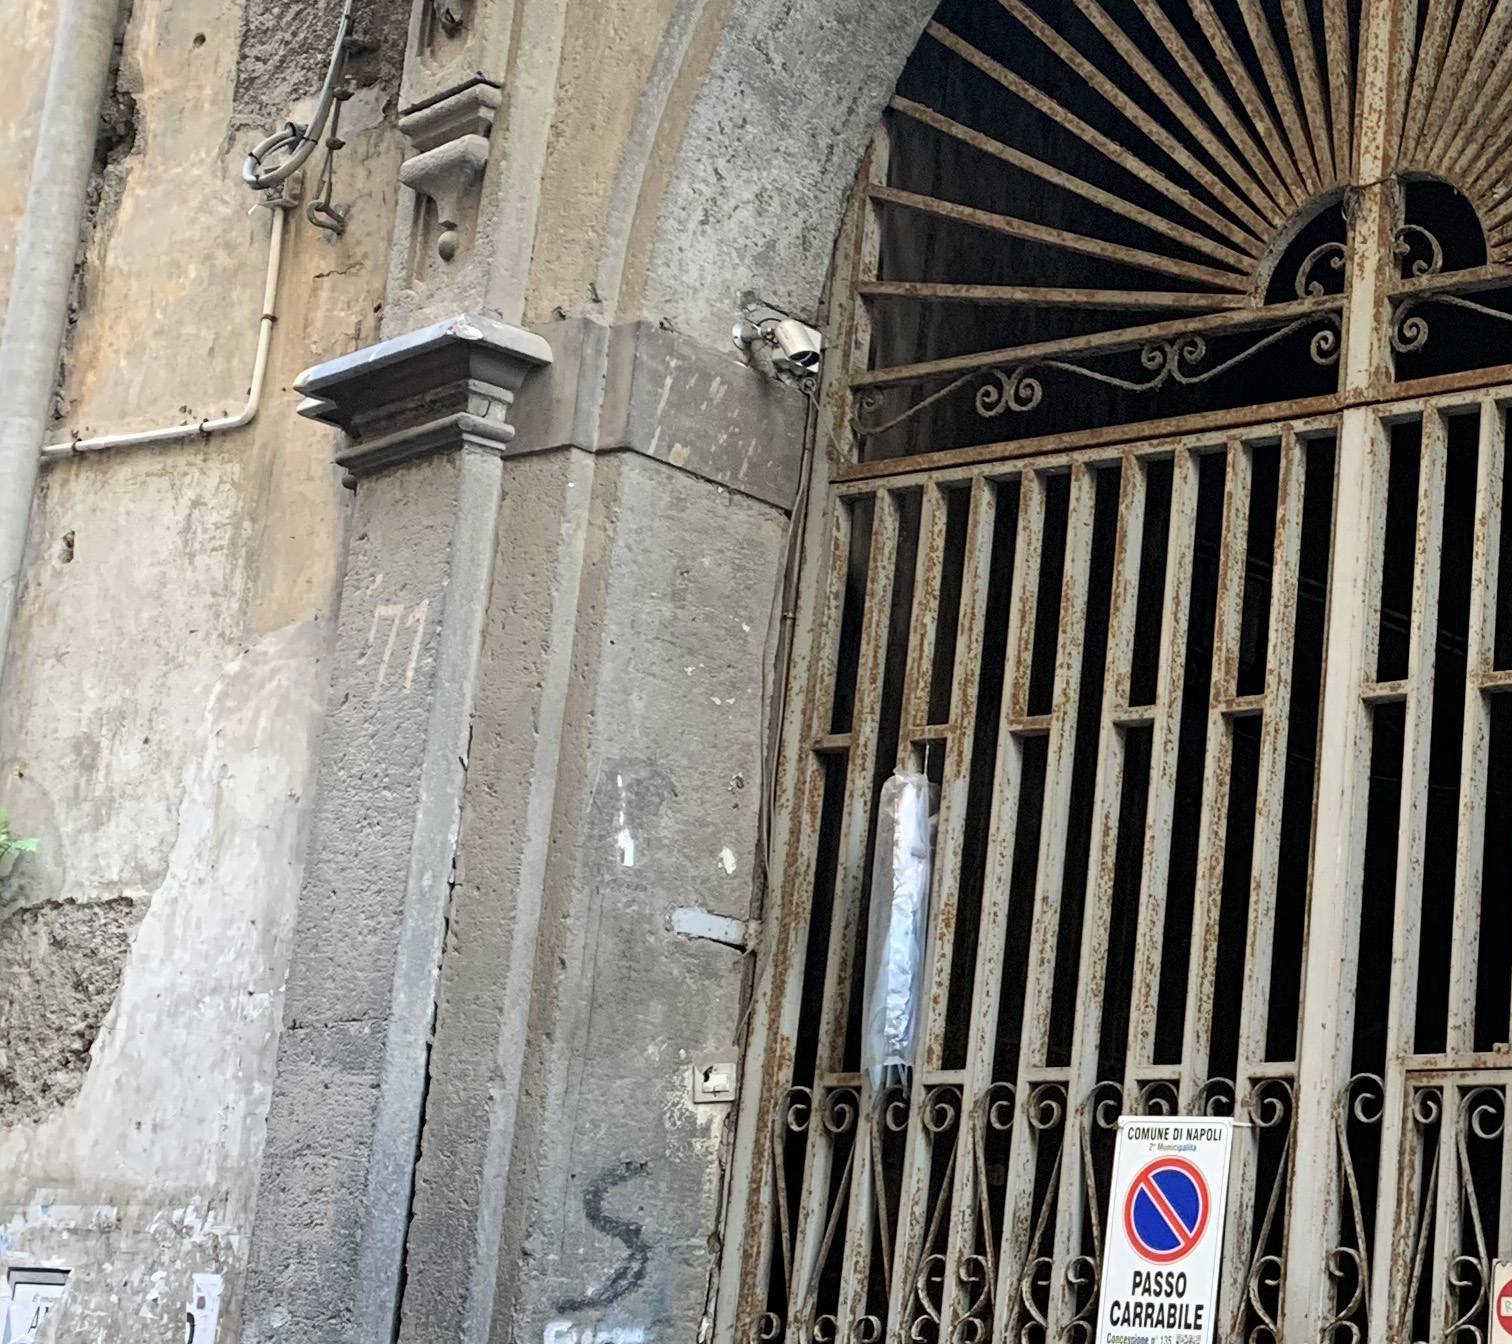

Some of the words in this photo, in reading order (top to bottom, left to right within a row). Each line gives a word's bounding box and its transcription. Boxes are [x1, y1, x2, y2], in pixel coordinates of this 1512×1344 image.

[358, 598, 430, 701] 71
[1127, 1127, 1169, 1141] COMUNE
[1172, 1128, 1183, 1141] DI
[1186, 1128, 1222, 1142] NAPOLI
[1131, 1270, 1187, 1298] PASSO
[1109, 1300, 1204, 1331] CARRABILE
